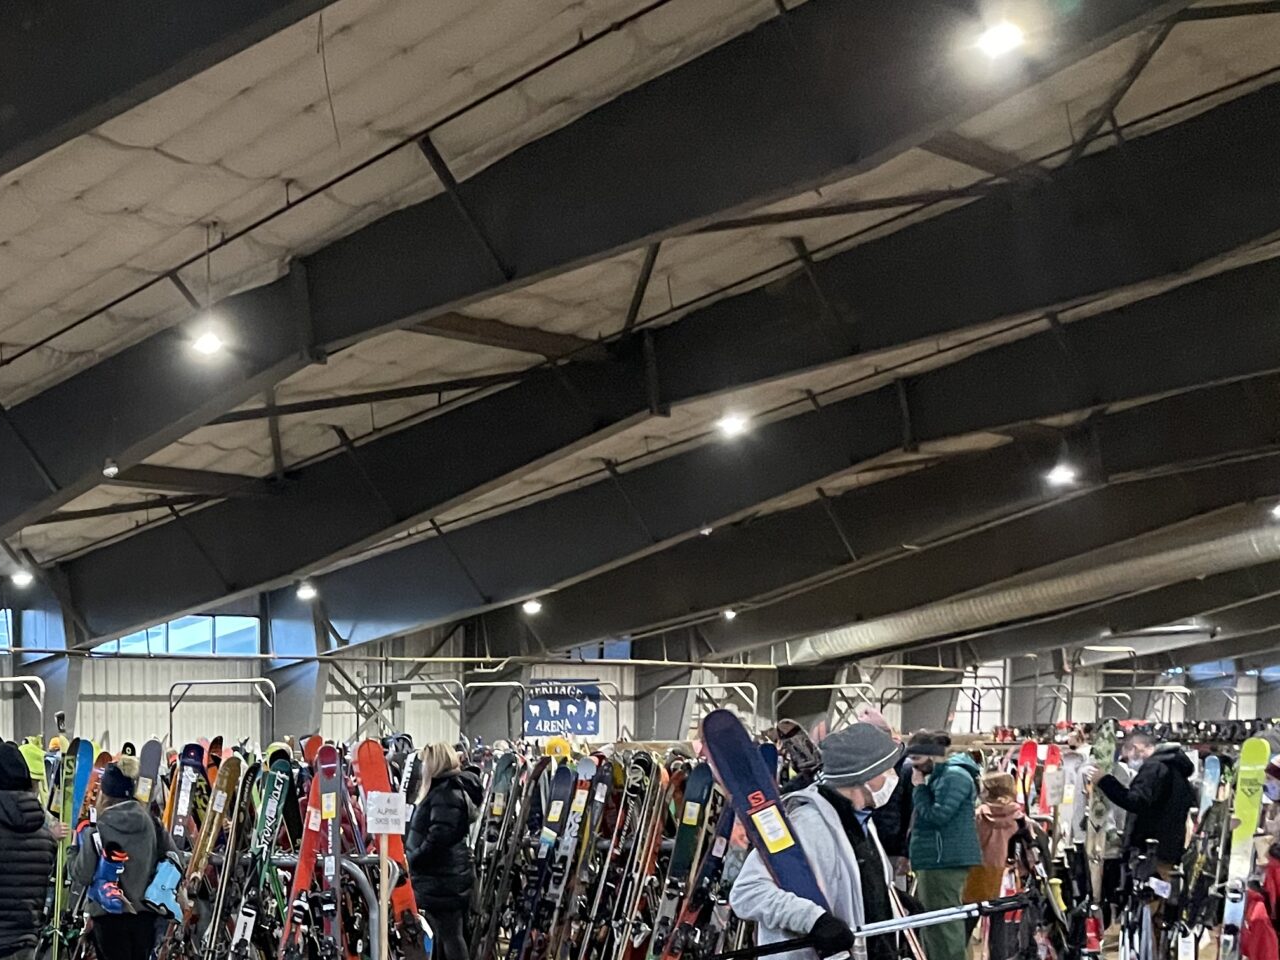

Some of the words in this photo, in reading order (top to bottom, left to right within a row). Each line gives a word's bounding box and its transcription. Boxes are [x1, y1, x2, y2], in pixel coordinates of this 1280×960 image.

[535, 718, 572, 733] ARENA
[749, 791, 764, 806] S
[255, 770, 290, 861] STORIDER
[377, 807, 398, 816] ALPINE
